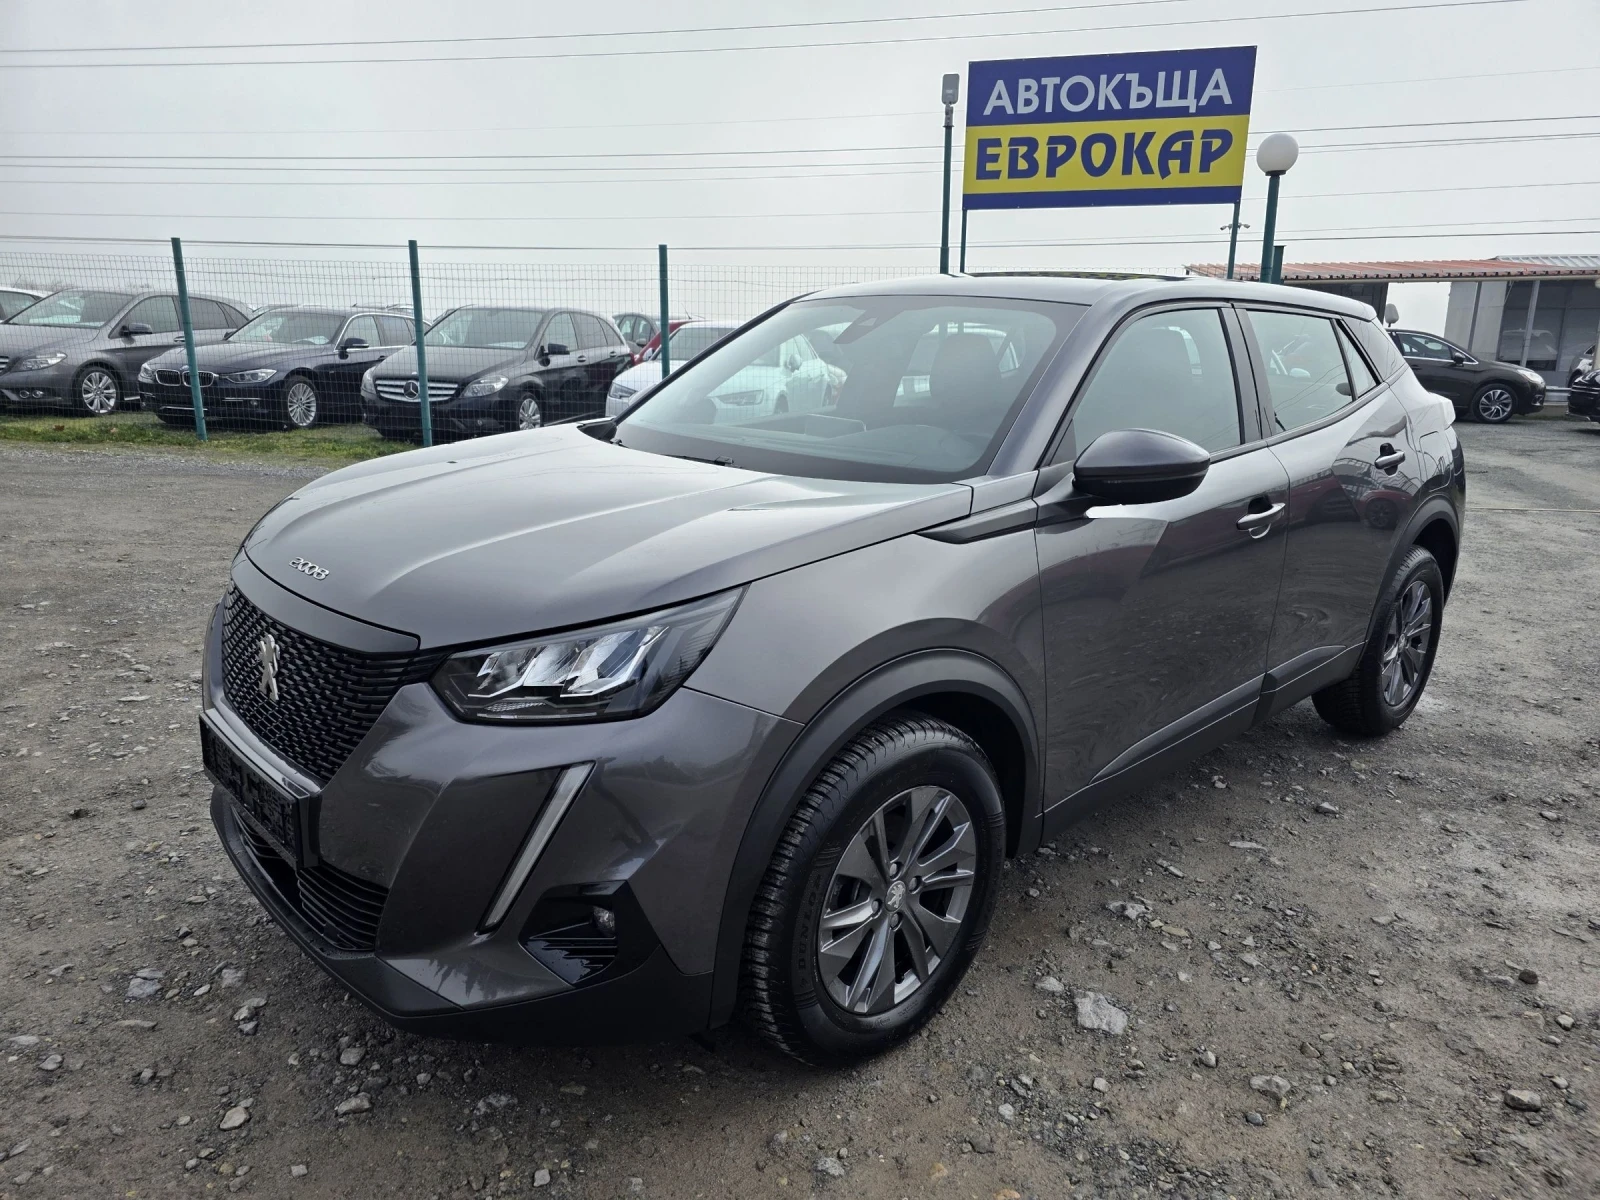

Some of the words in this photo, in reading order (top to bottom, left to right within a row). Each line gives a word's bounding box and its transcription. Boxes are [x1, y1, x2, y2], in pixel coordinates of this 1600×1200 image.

[983, 68, 1232, 115] АВТОКЪЩА
[975, 129, 1233, 180] ЕВРОКАР
[289, 556, 330, 581] 2008
